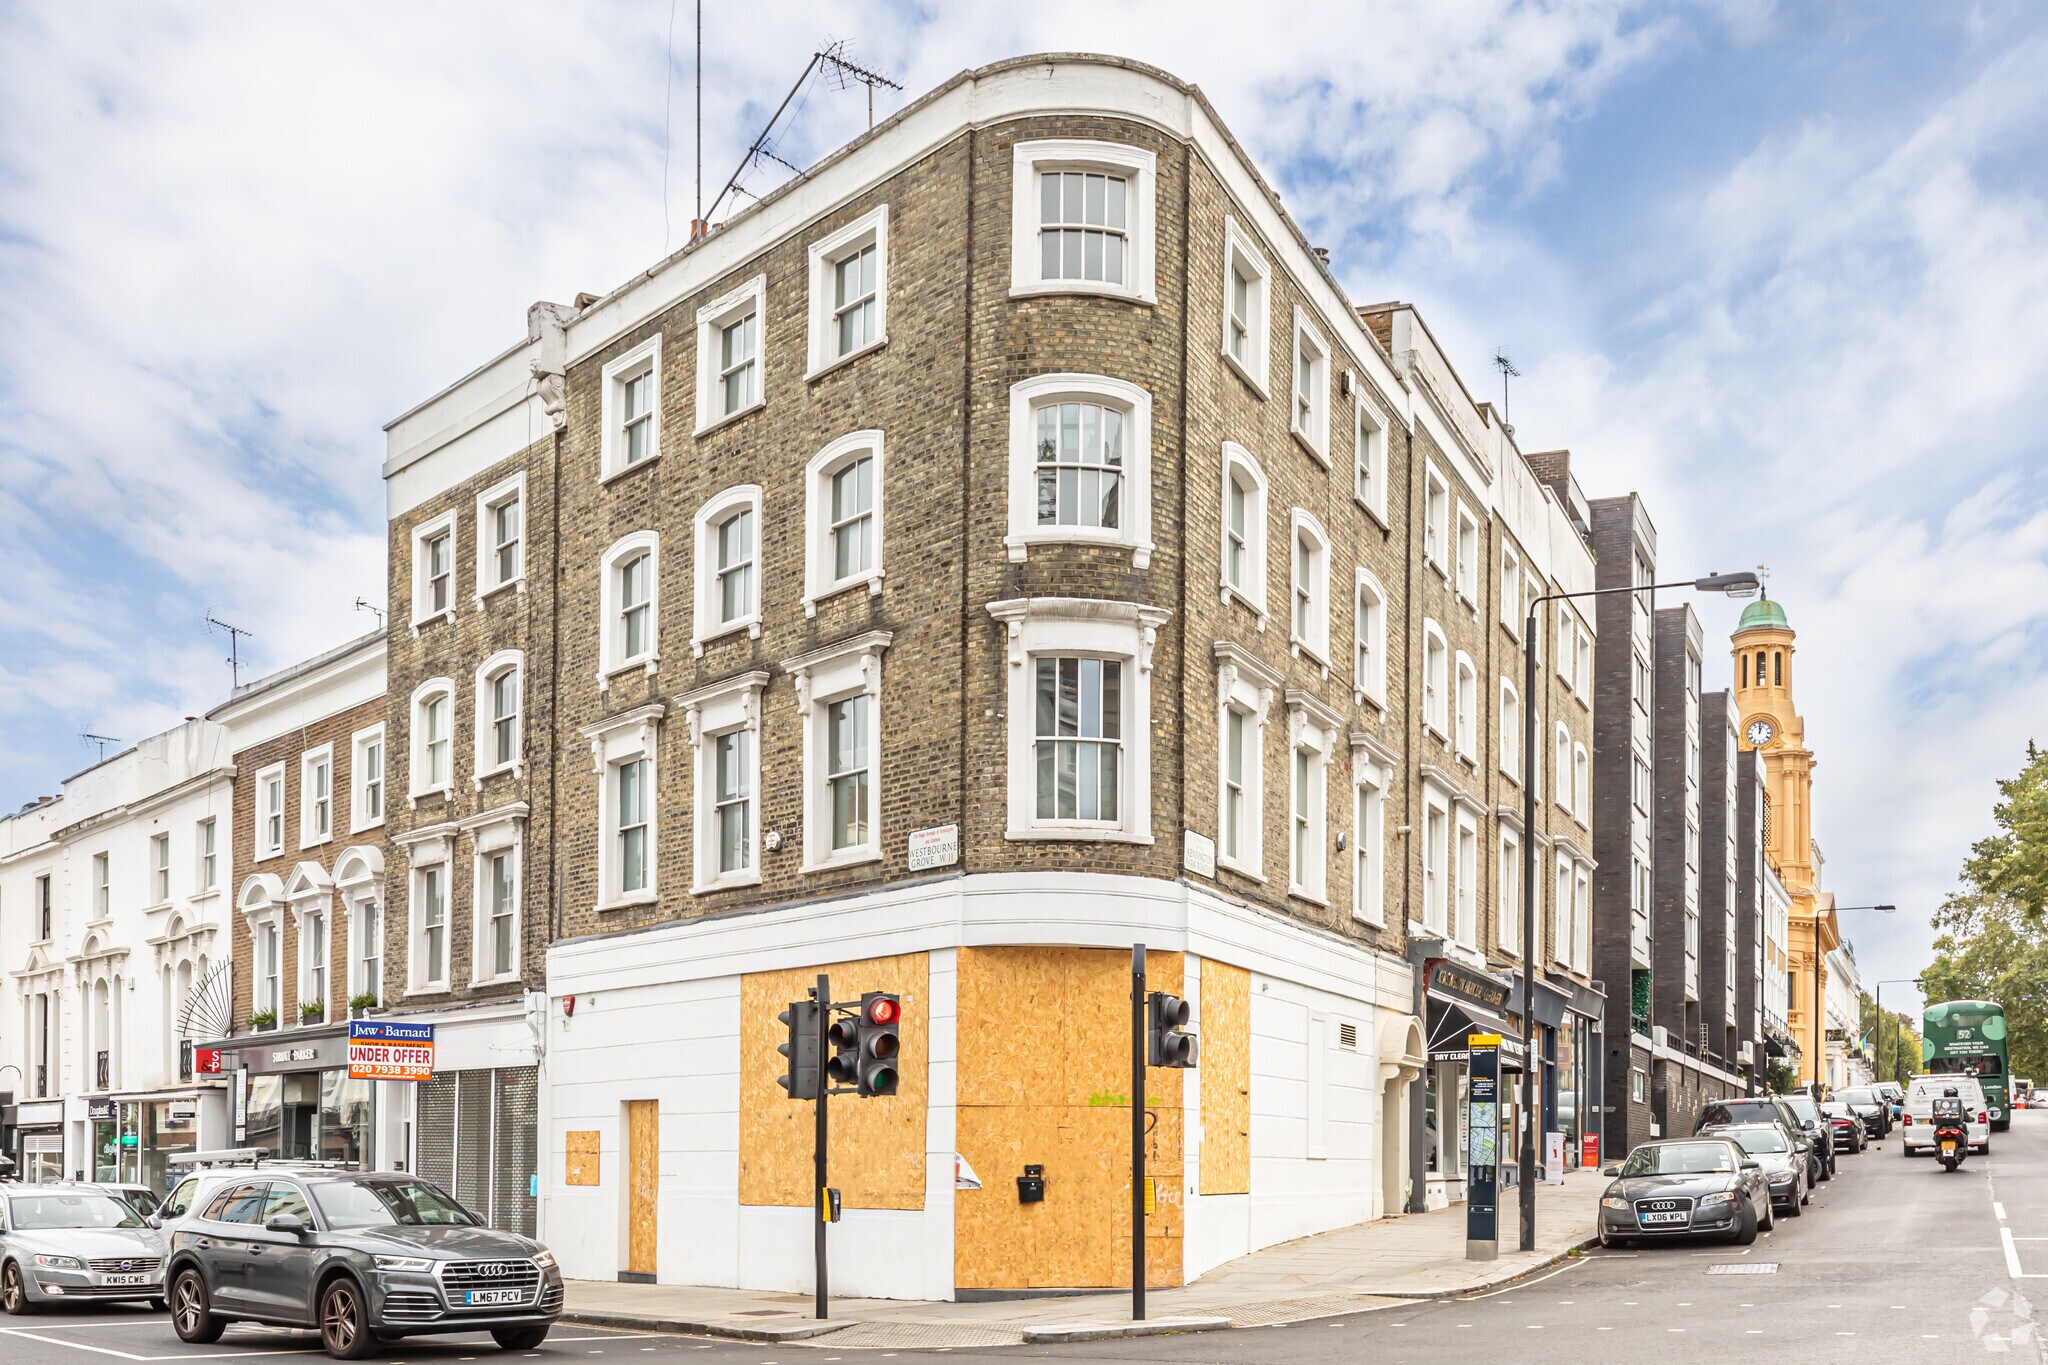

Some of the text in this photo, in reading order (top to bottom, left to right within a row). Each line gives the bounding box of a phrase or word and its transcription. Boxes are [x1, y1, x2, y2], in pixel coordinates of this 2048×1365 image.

[909, 841, 957, 858] WESTBOURNE
[911, 856, 935, 868] GROVE
[385, 1025, 431, 1038] Barnard
[1958, 1030, 1971, 1039] 52
[350, 1047, 430, 1064] UNDER OFFER
[1434, 1053, 1449, 1061] DRY
[352, 1064, 430, 1075] 020 7938 3990
[106, 1275, 145, 1284] KW15 CWE
[473, 1291, 519, 1303] LM67 PCV
